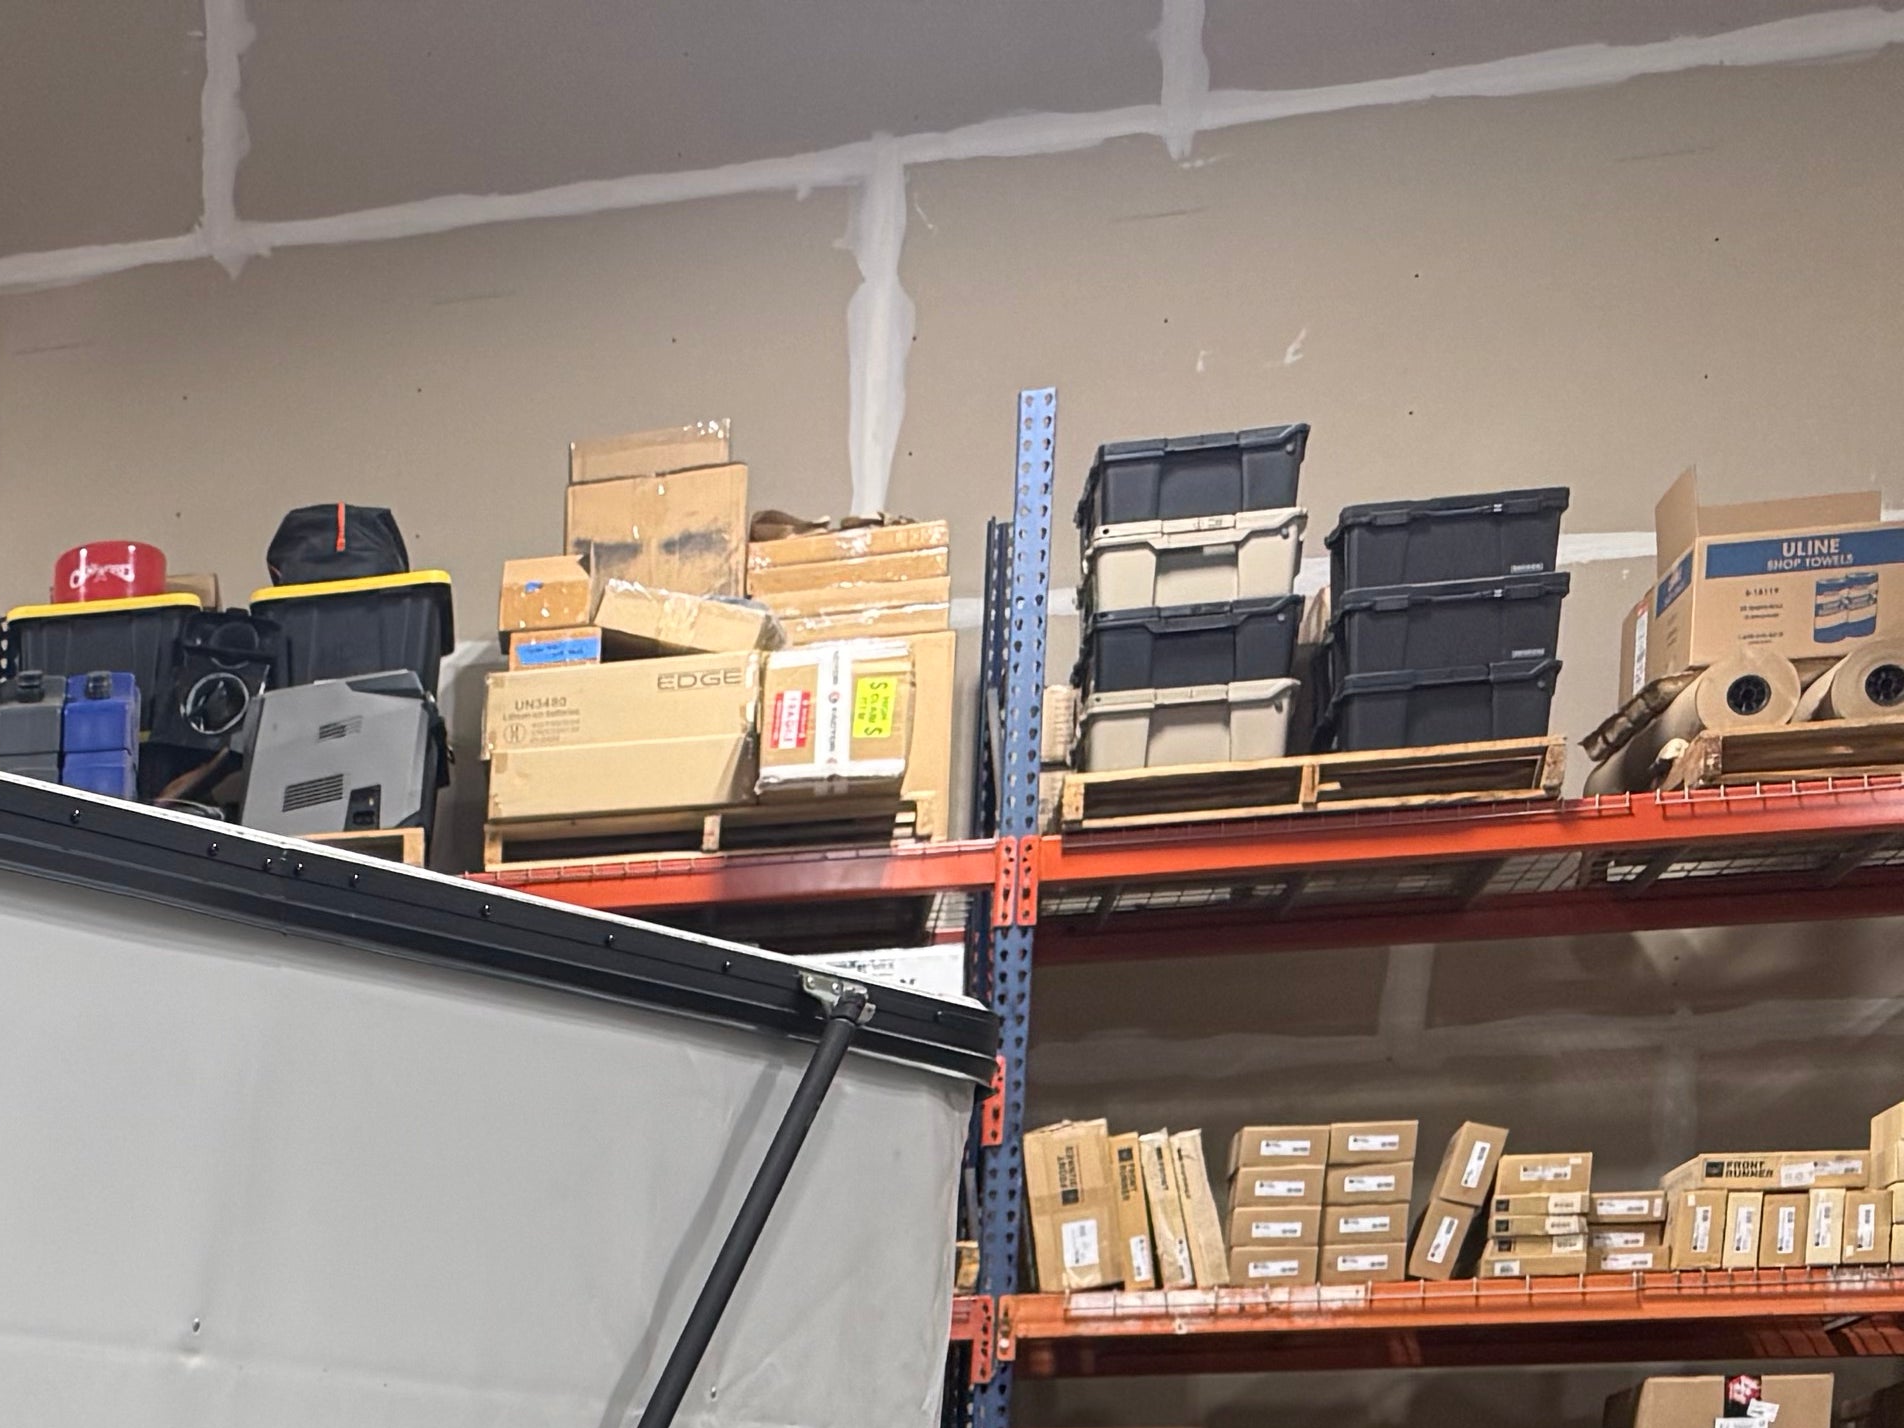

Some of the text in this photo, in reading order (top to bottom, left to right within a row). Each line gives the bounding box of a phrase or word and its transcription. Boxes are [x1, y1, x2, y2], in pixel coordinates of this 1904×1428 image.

[1782, 538, 1841, 558] ULINE
[1767, 553, 1854, 572] SHOP TOWELS
[657, 669, 743, 691] EDGE
[515, 697, 567, 711] UN3480
[1726, 1160, 1766, 1170] FRONT
[1725, 1168, 1774, 1179] RUNNER
